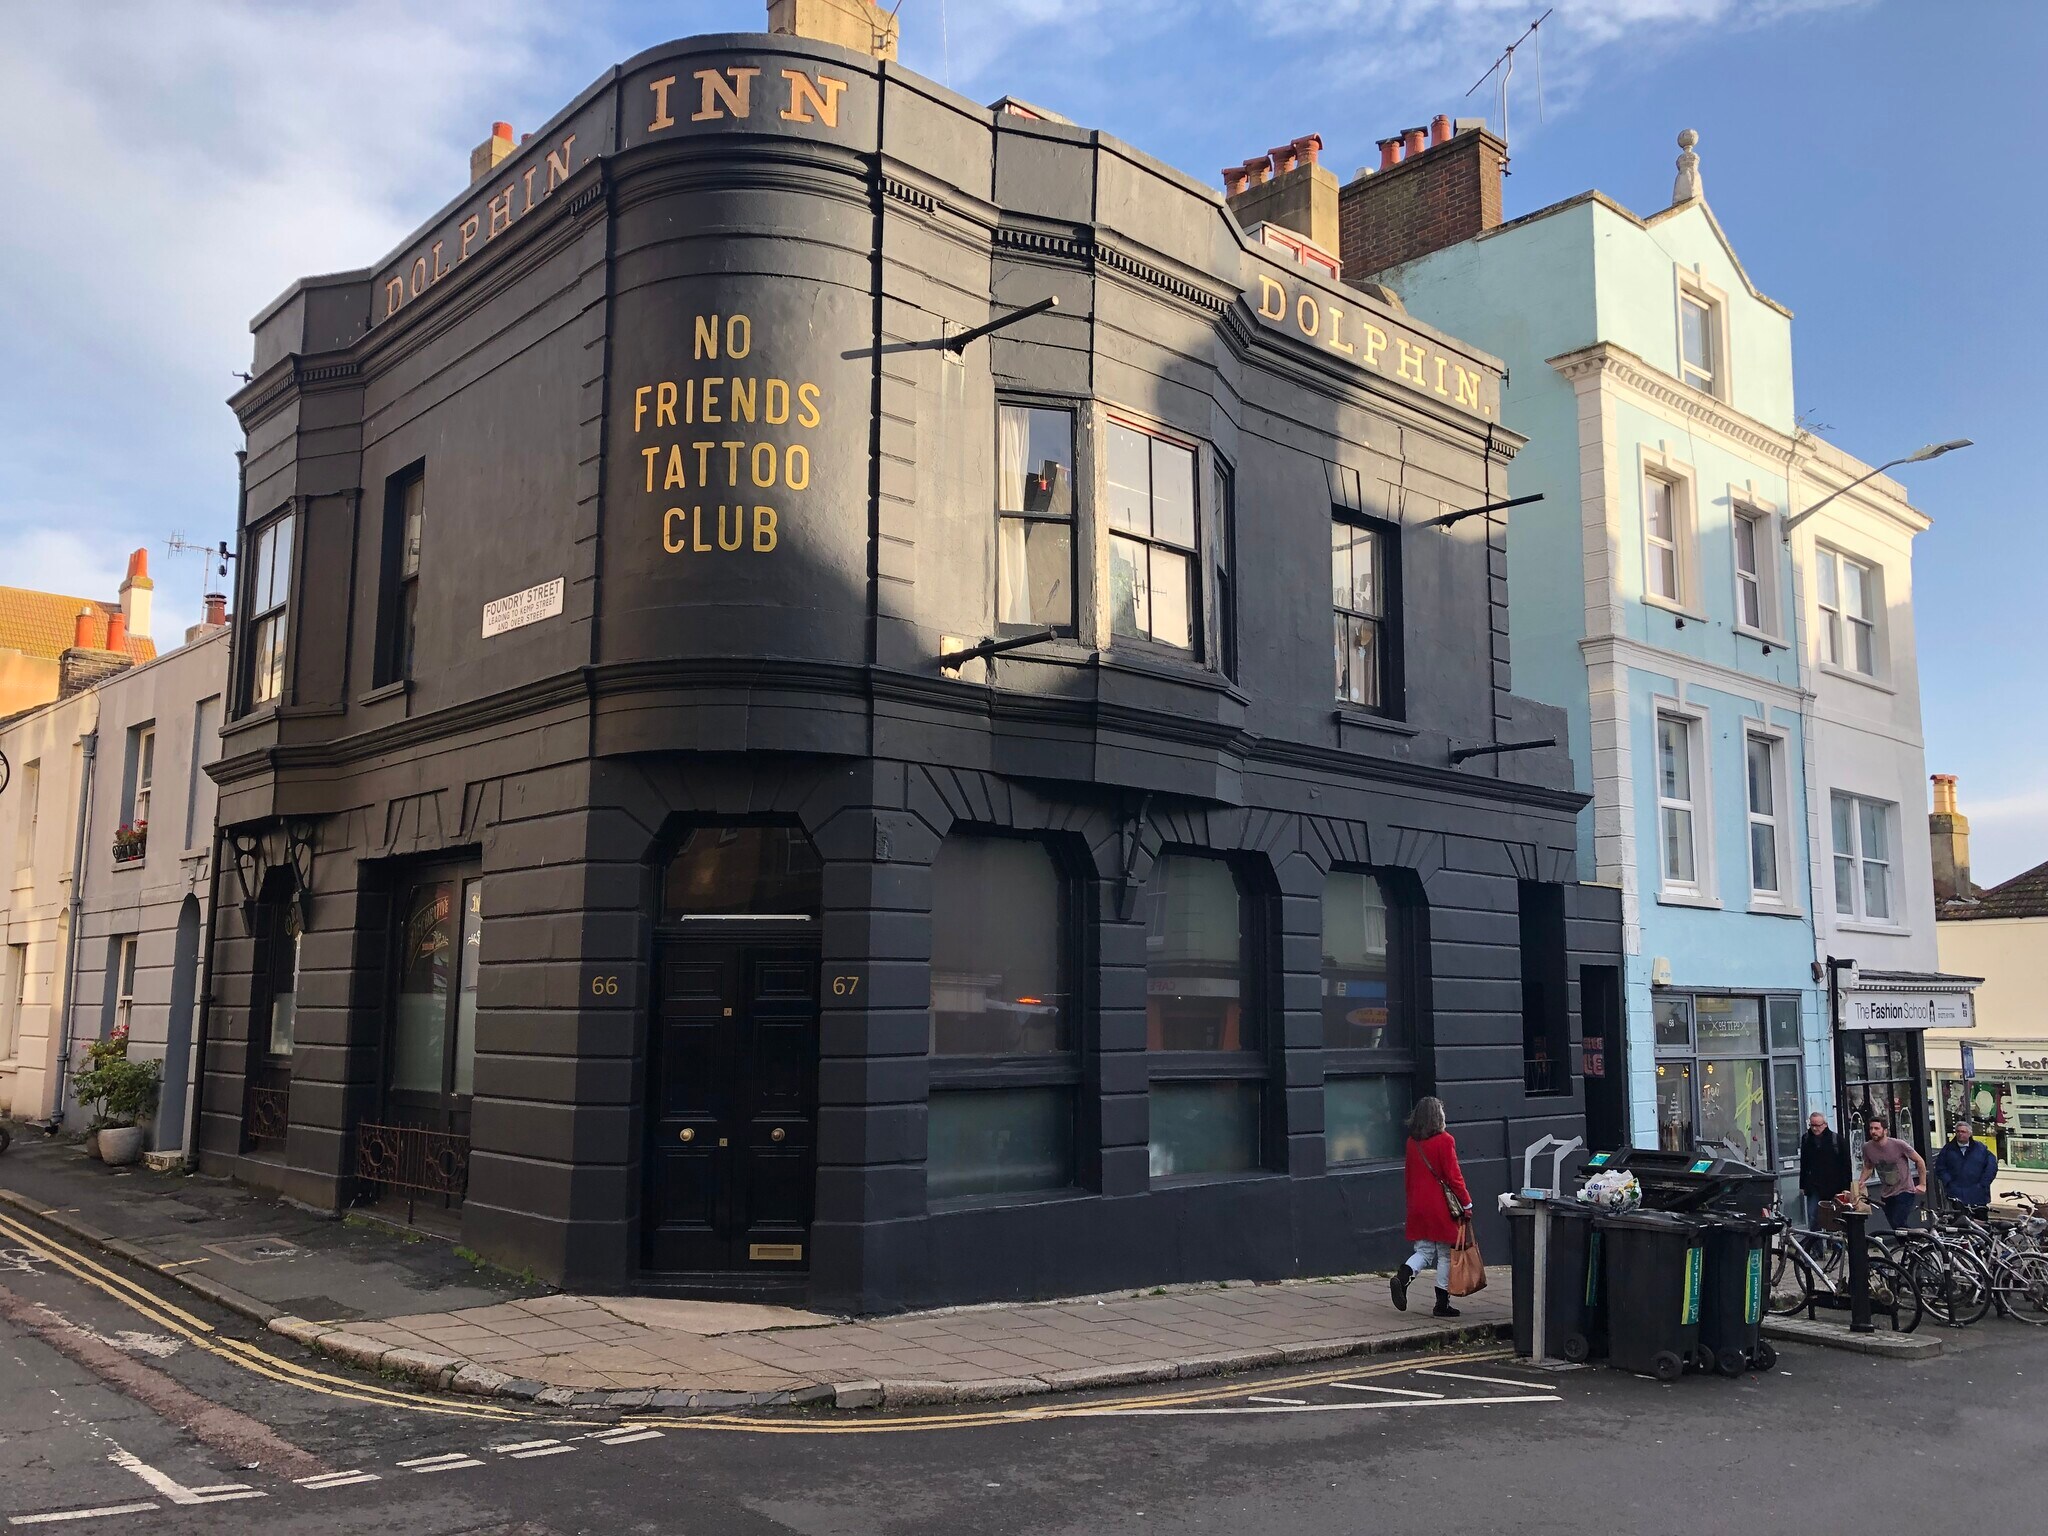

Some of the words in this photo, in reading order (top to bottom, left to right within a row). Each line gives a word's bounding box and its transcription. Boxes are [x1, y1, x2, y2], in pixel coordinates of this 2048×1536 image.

[648, 66, 849, 132] INN
[694, 314, 752, 361] NO
[634, 377, 821, 433] FRIENDS
[641, 441, 810, 493] TATTOO
[663, 505, 778, 554] CLUB
[486, 594, 524, 617] FOUNDRY
[527, 581, 560, 603] STREET
[489, 612, 510, 625] LEADING
[511, 608, 518, 618] TO
[520, 605, 533, 615] KEMP
[536, 597, 555, 609] STREET
[497, 622, 508, 631] AND
[511, 617, 524, 627] OVER
[527, 609, 546, 622] STREET
[592, 976, 619, 996] 66
[832, 976, 860, 996] 67
[1855, 1002, 1871, 1019] The
[1871, 1002, 1903, 1019] Fashion
[1903, 1001, 1928, 1019] School
